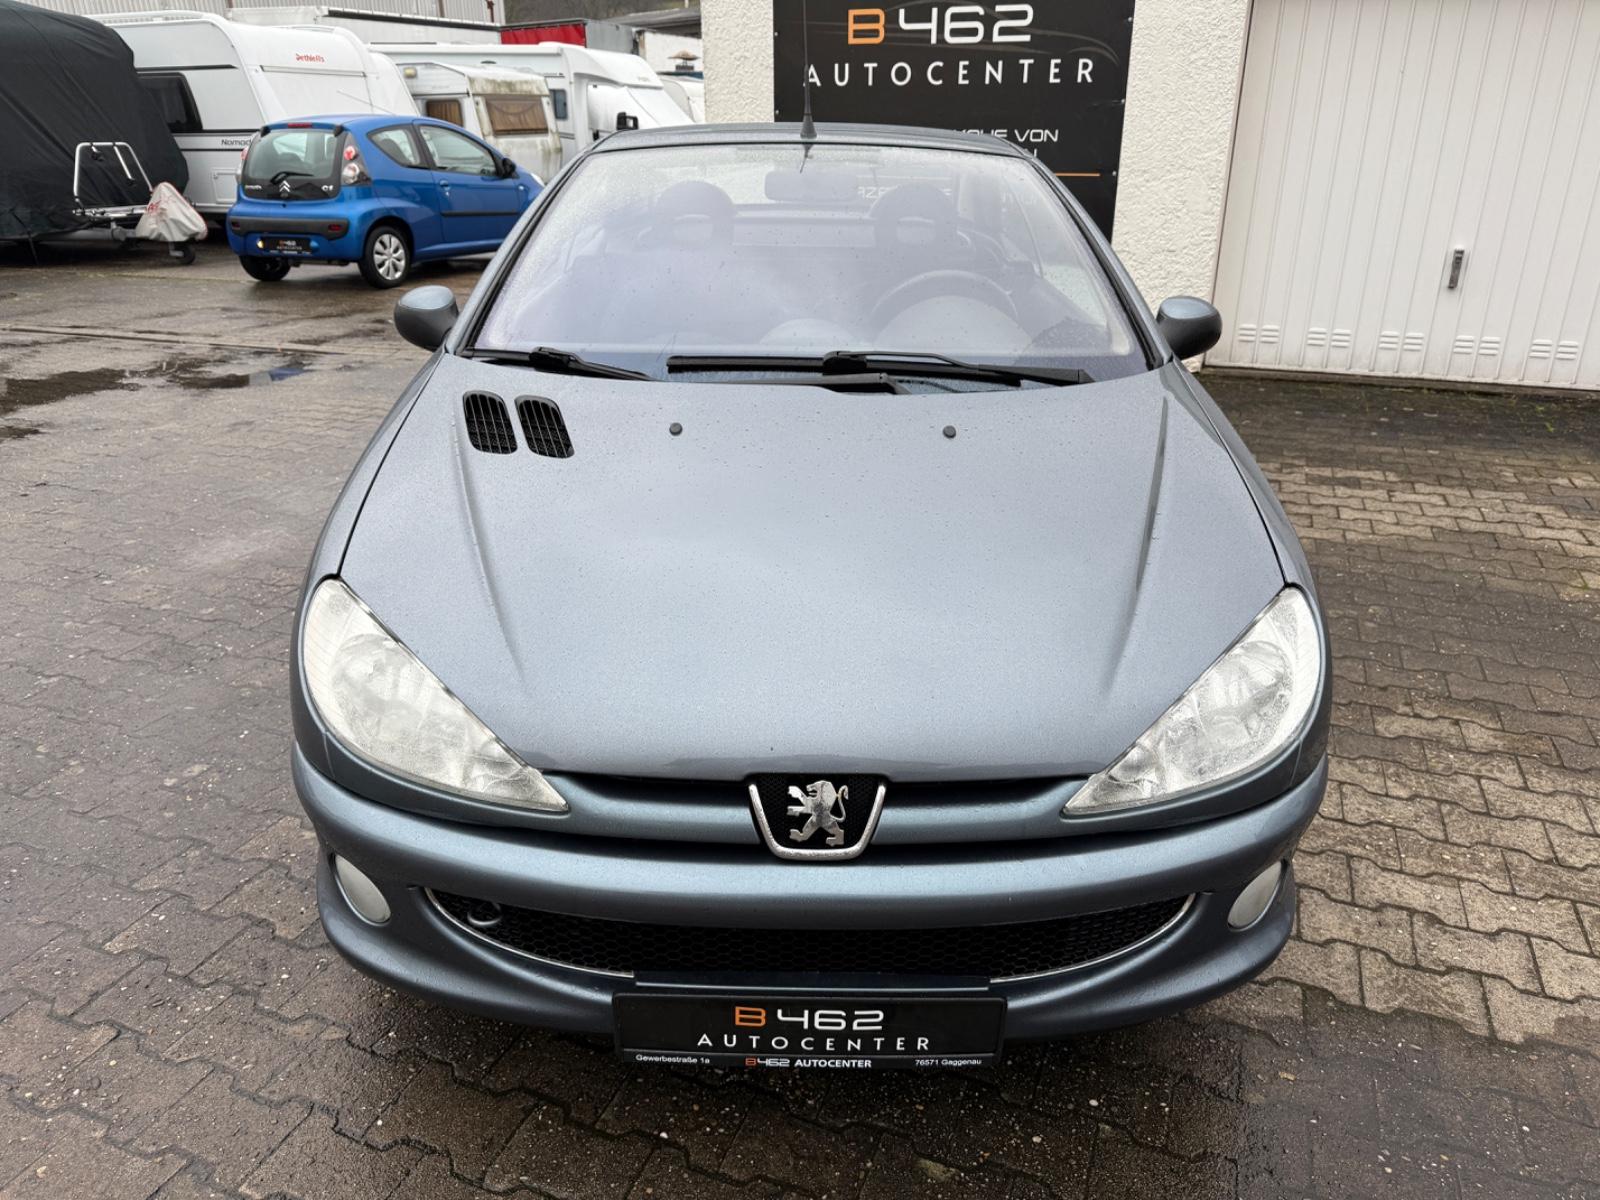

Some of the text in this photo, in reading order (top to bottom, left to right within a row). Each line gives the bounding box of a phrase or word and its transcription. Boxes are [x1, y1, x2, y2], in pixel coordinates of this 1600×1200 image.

[847, 3, 1034, 45] B 462
[803, 58, 1094, 87] AUTOCENTER
[1014, 128, 1059, 142] VON
[734, 1005, 885, 1031] B 462
[697, 1032, 930, 1052] AUTOCENTER
[635, 1053, 710, 1065] Gewerbestraße 1a
[794, 1059, 872, 1068] AUTOCENTER
[941, 1058, 982, 1066] Gaggenau
